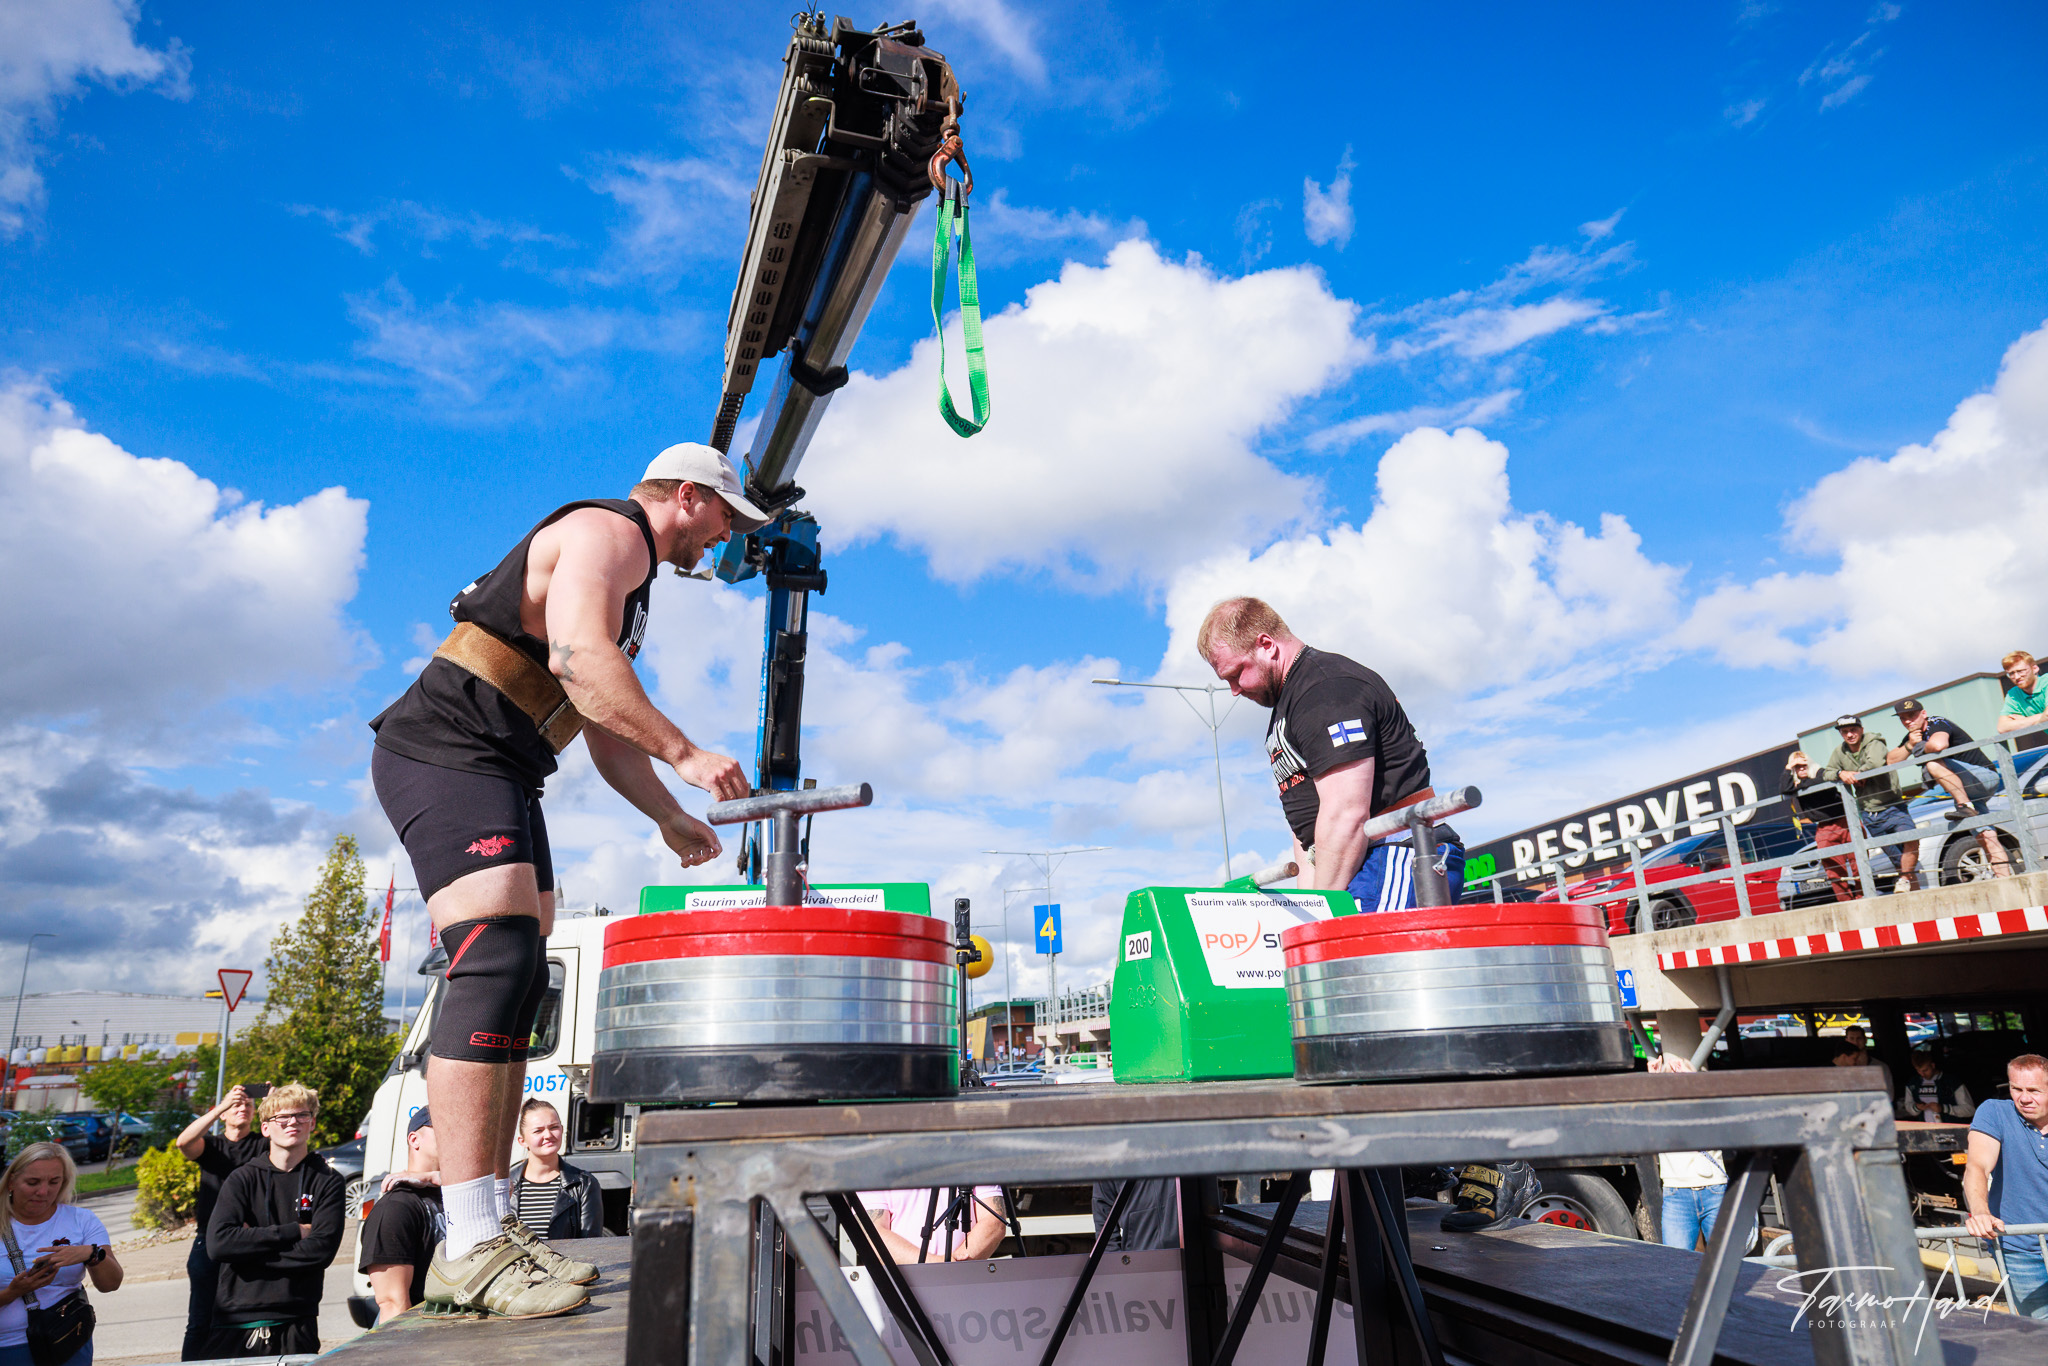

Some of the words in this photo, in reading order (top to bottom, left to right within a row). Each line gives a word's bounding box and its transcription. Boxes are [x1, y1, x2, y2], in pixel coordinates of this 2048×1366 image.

[1512, 771, 1758, 882] RESERVED
[691, 898, 736, 907] Suurim
[1191, 898, 1224, 906] Suurim
[1226, 898, 1247, 907] valik
[1250, 899, 1325, 909] spordivahendeid!
[1040, 916, 1057, 941] 4
[1128, 938, 1149, 955] 200
[1205, 933, 1248, 949] POP
[1236, 969, 1283, 980] www.po
[471, 1032, 511, 1047] SBD
